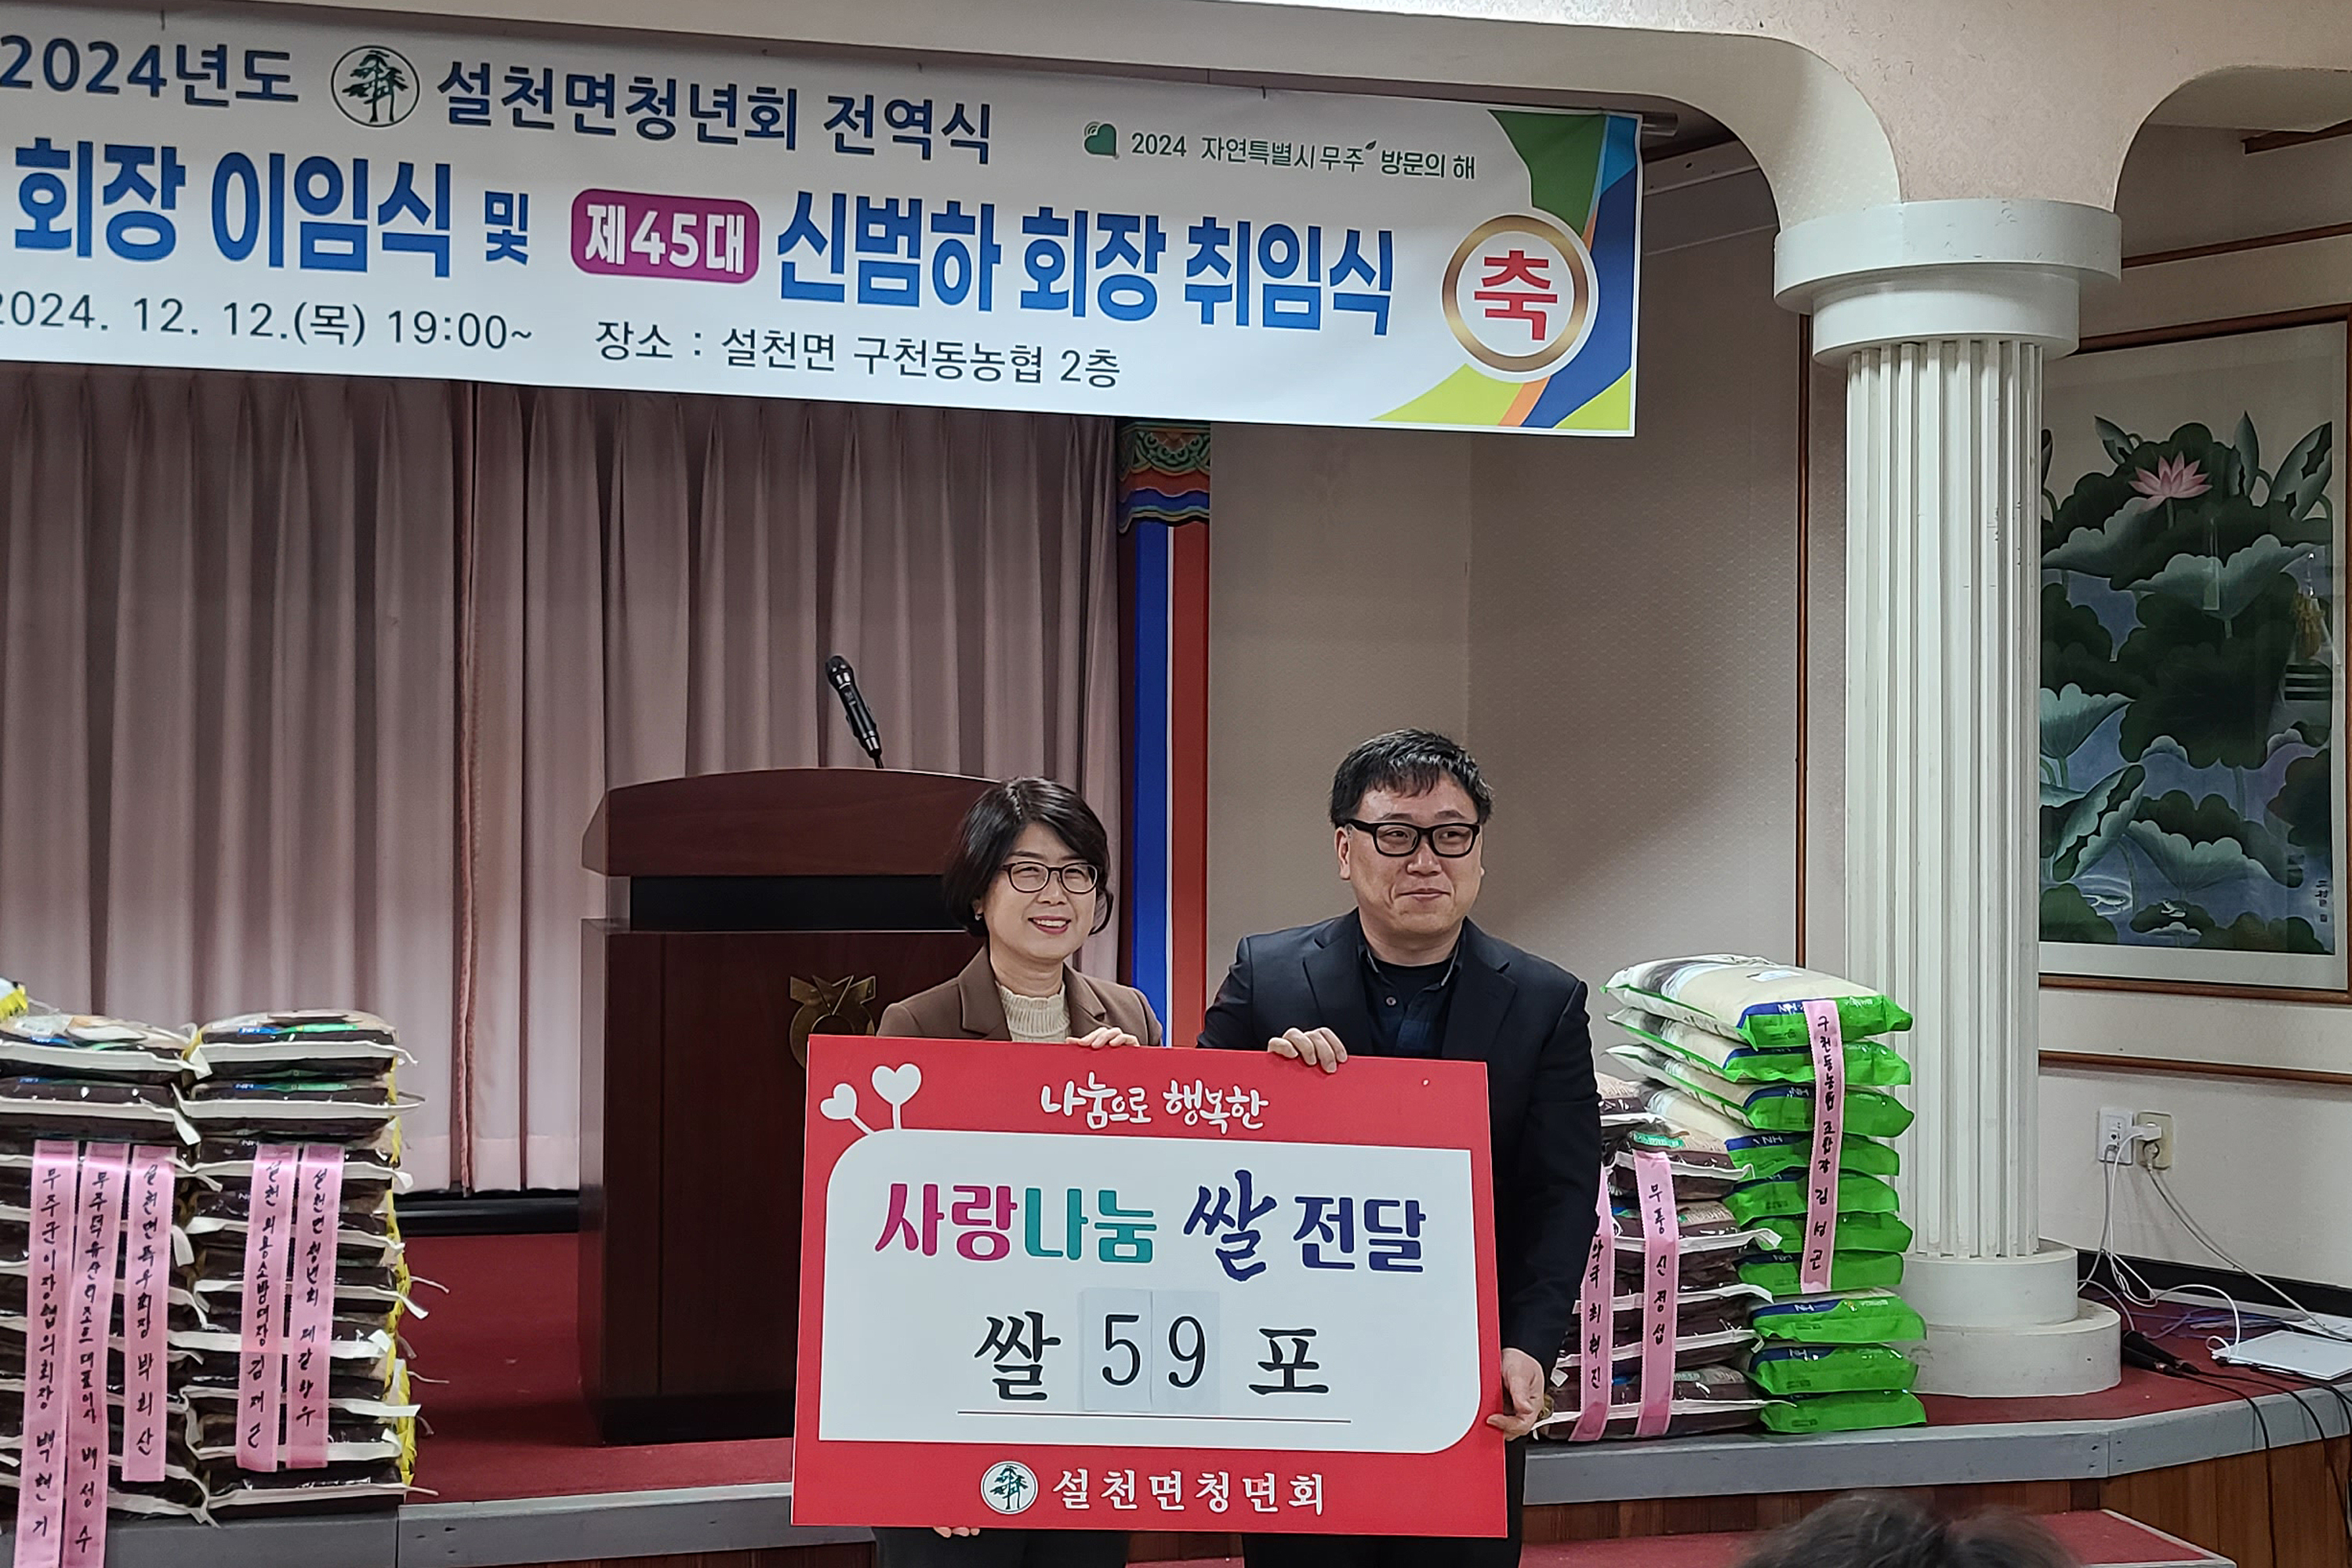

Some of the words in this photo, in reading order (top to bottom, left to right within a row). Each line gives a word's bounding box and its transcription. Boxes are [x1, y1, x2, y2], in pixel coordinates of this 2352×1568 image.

[0, 34, 299, 107] 2024년도
[437, 60, 797, 151] 설천면청년회
[823, 93, 991, 165] 전역식
[1131, 132, 1188, 158] 2024
[1380, 148, 1446, 179] 방문의
[1452, 154, 1475, 180] 해
[15, 137, 186, 262] 회장
[211, 152, 451, 278] 이임식
[483, 191, 529, 267] 및
[585, 203, 746, 276] 제45대
[777, 191, 1001, 312] 신범하
[1020, 206, 1167, 322] 회장
[1184, 216, 1394, 336] 취임식
[0, 291, 108, 331] 024.
[134, 298, 198, 336] 12.
[387, 310, 533, 350] 19:00~
[594, 320, 673, 361] 장소
[720, 326, 836, 372] 설천면
[853, 336, 1044, 385] 구천동농협
[1060, 348, 1121, 390] 2층
[1474, 249, 1559, 342] 축
[1040, 1072, 1152, 1130] 나눔으로
[1163, 1078, 1269, 1134] 행복한
[874, 1182, 1158, 1264] 사랑나눔
[1183, 1169, 1278, 1283] 쌀
[1292, 1194, 1427, 1273] 전달
[973, 1310, 1062, 1401] 쌀
[1100, 1313, 1207, 1390] 59
[1247, 1327, 1330, 1396] 포
